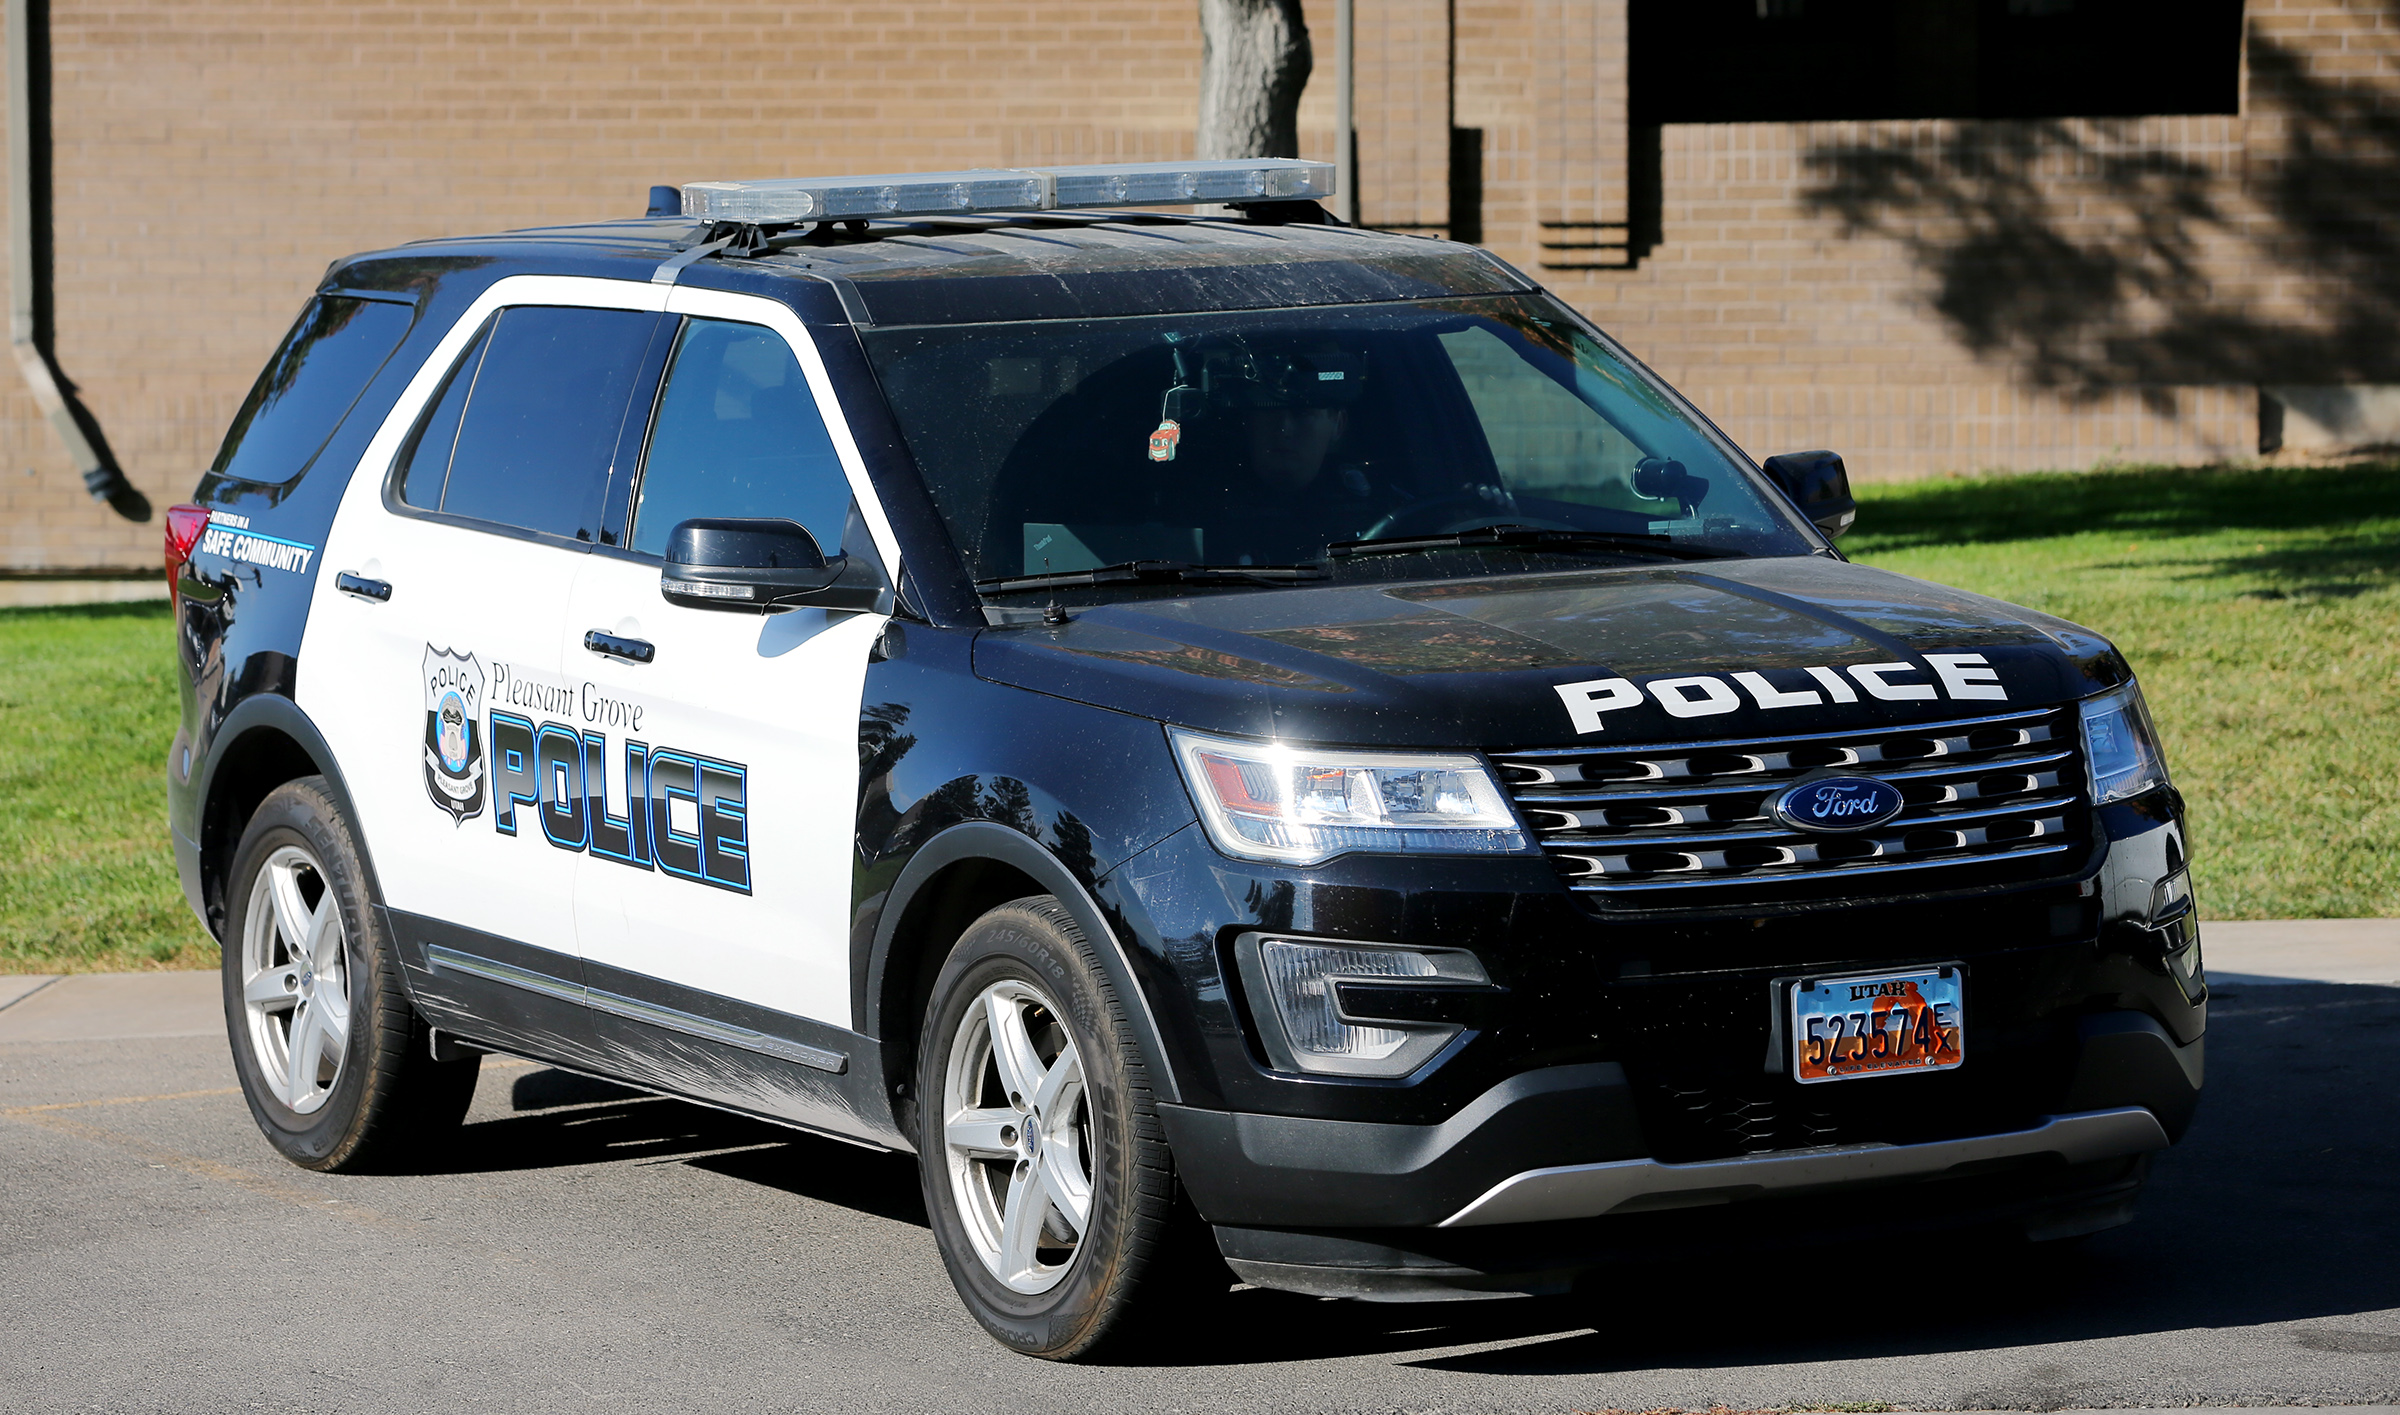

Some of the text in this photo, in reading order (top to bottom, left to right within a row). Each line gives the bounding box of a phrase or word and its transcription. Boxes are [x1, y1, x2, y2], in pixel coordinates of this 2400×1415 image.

[210, 510, 238, 527] PARTNERS
[203, 529, 314, 574] SAFE COMMUNITY
[430, 666, 477, 706] POLICE
[491, 661, 644, 732] Pleasant Grove
[1553, 653, 2009, 735] POLICE
[490, 708, 753, 897] POLICE
[1812, 785, 1879, 818] Ford
[986, 929, 1065, 979] 245/60R18
[1849, 981, 1907, 1002] UTAH
[765, 1042, 835, 1067] EXPLORER
[1807, 1006, 1931, 1066] 523574
[1839, 1058, 1922, 1074] LIFE ELEVATED
